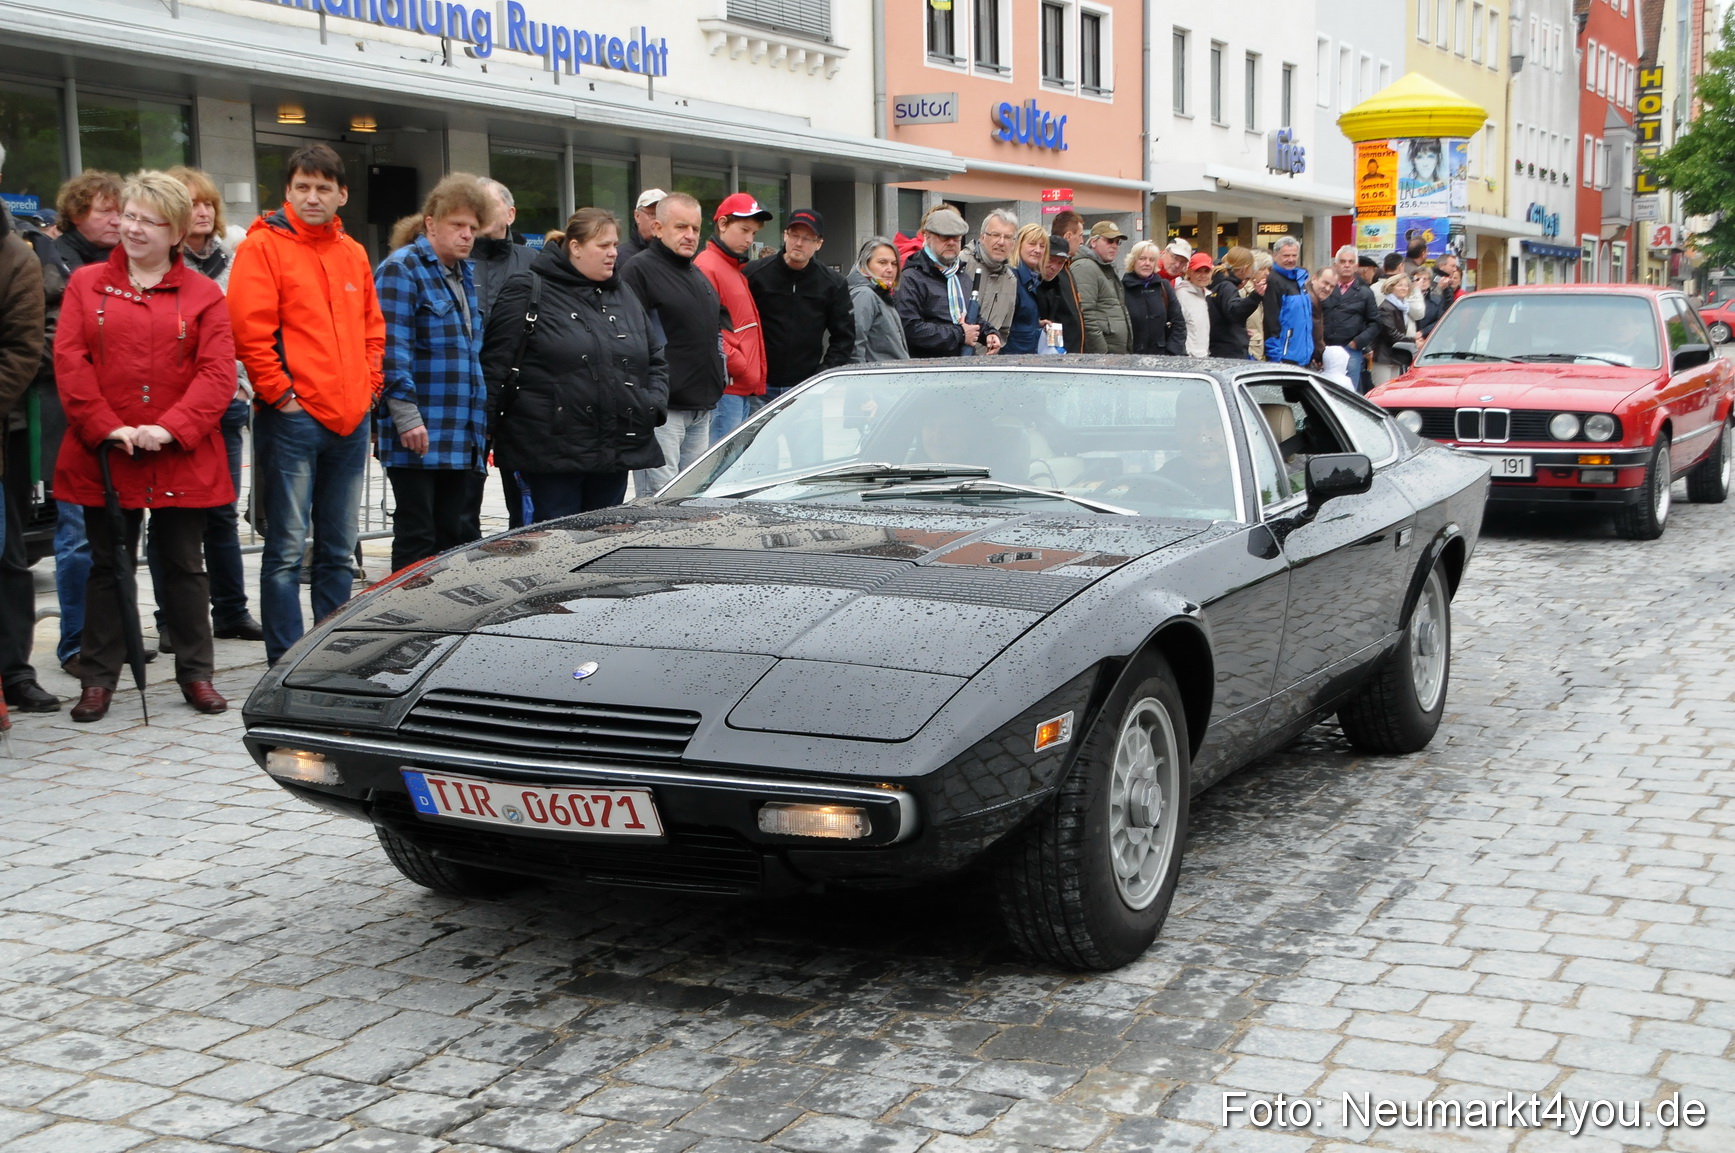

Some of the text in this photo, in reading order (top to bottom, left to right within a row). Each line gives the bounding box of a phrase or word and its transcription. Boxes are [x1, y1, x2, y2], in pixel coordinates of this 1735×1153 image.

[507, 0, 668, 77] Rupprecht
[1637, 68, 1662, 192] HOTEL
[1258, 224, 1288, 233] FRIES
[1501, 458, 1524, 474] 191
[419, 795, 429, 806] D
[427, 778, 646, 830] TIR 06071
